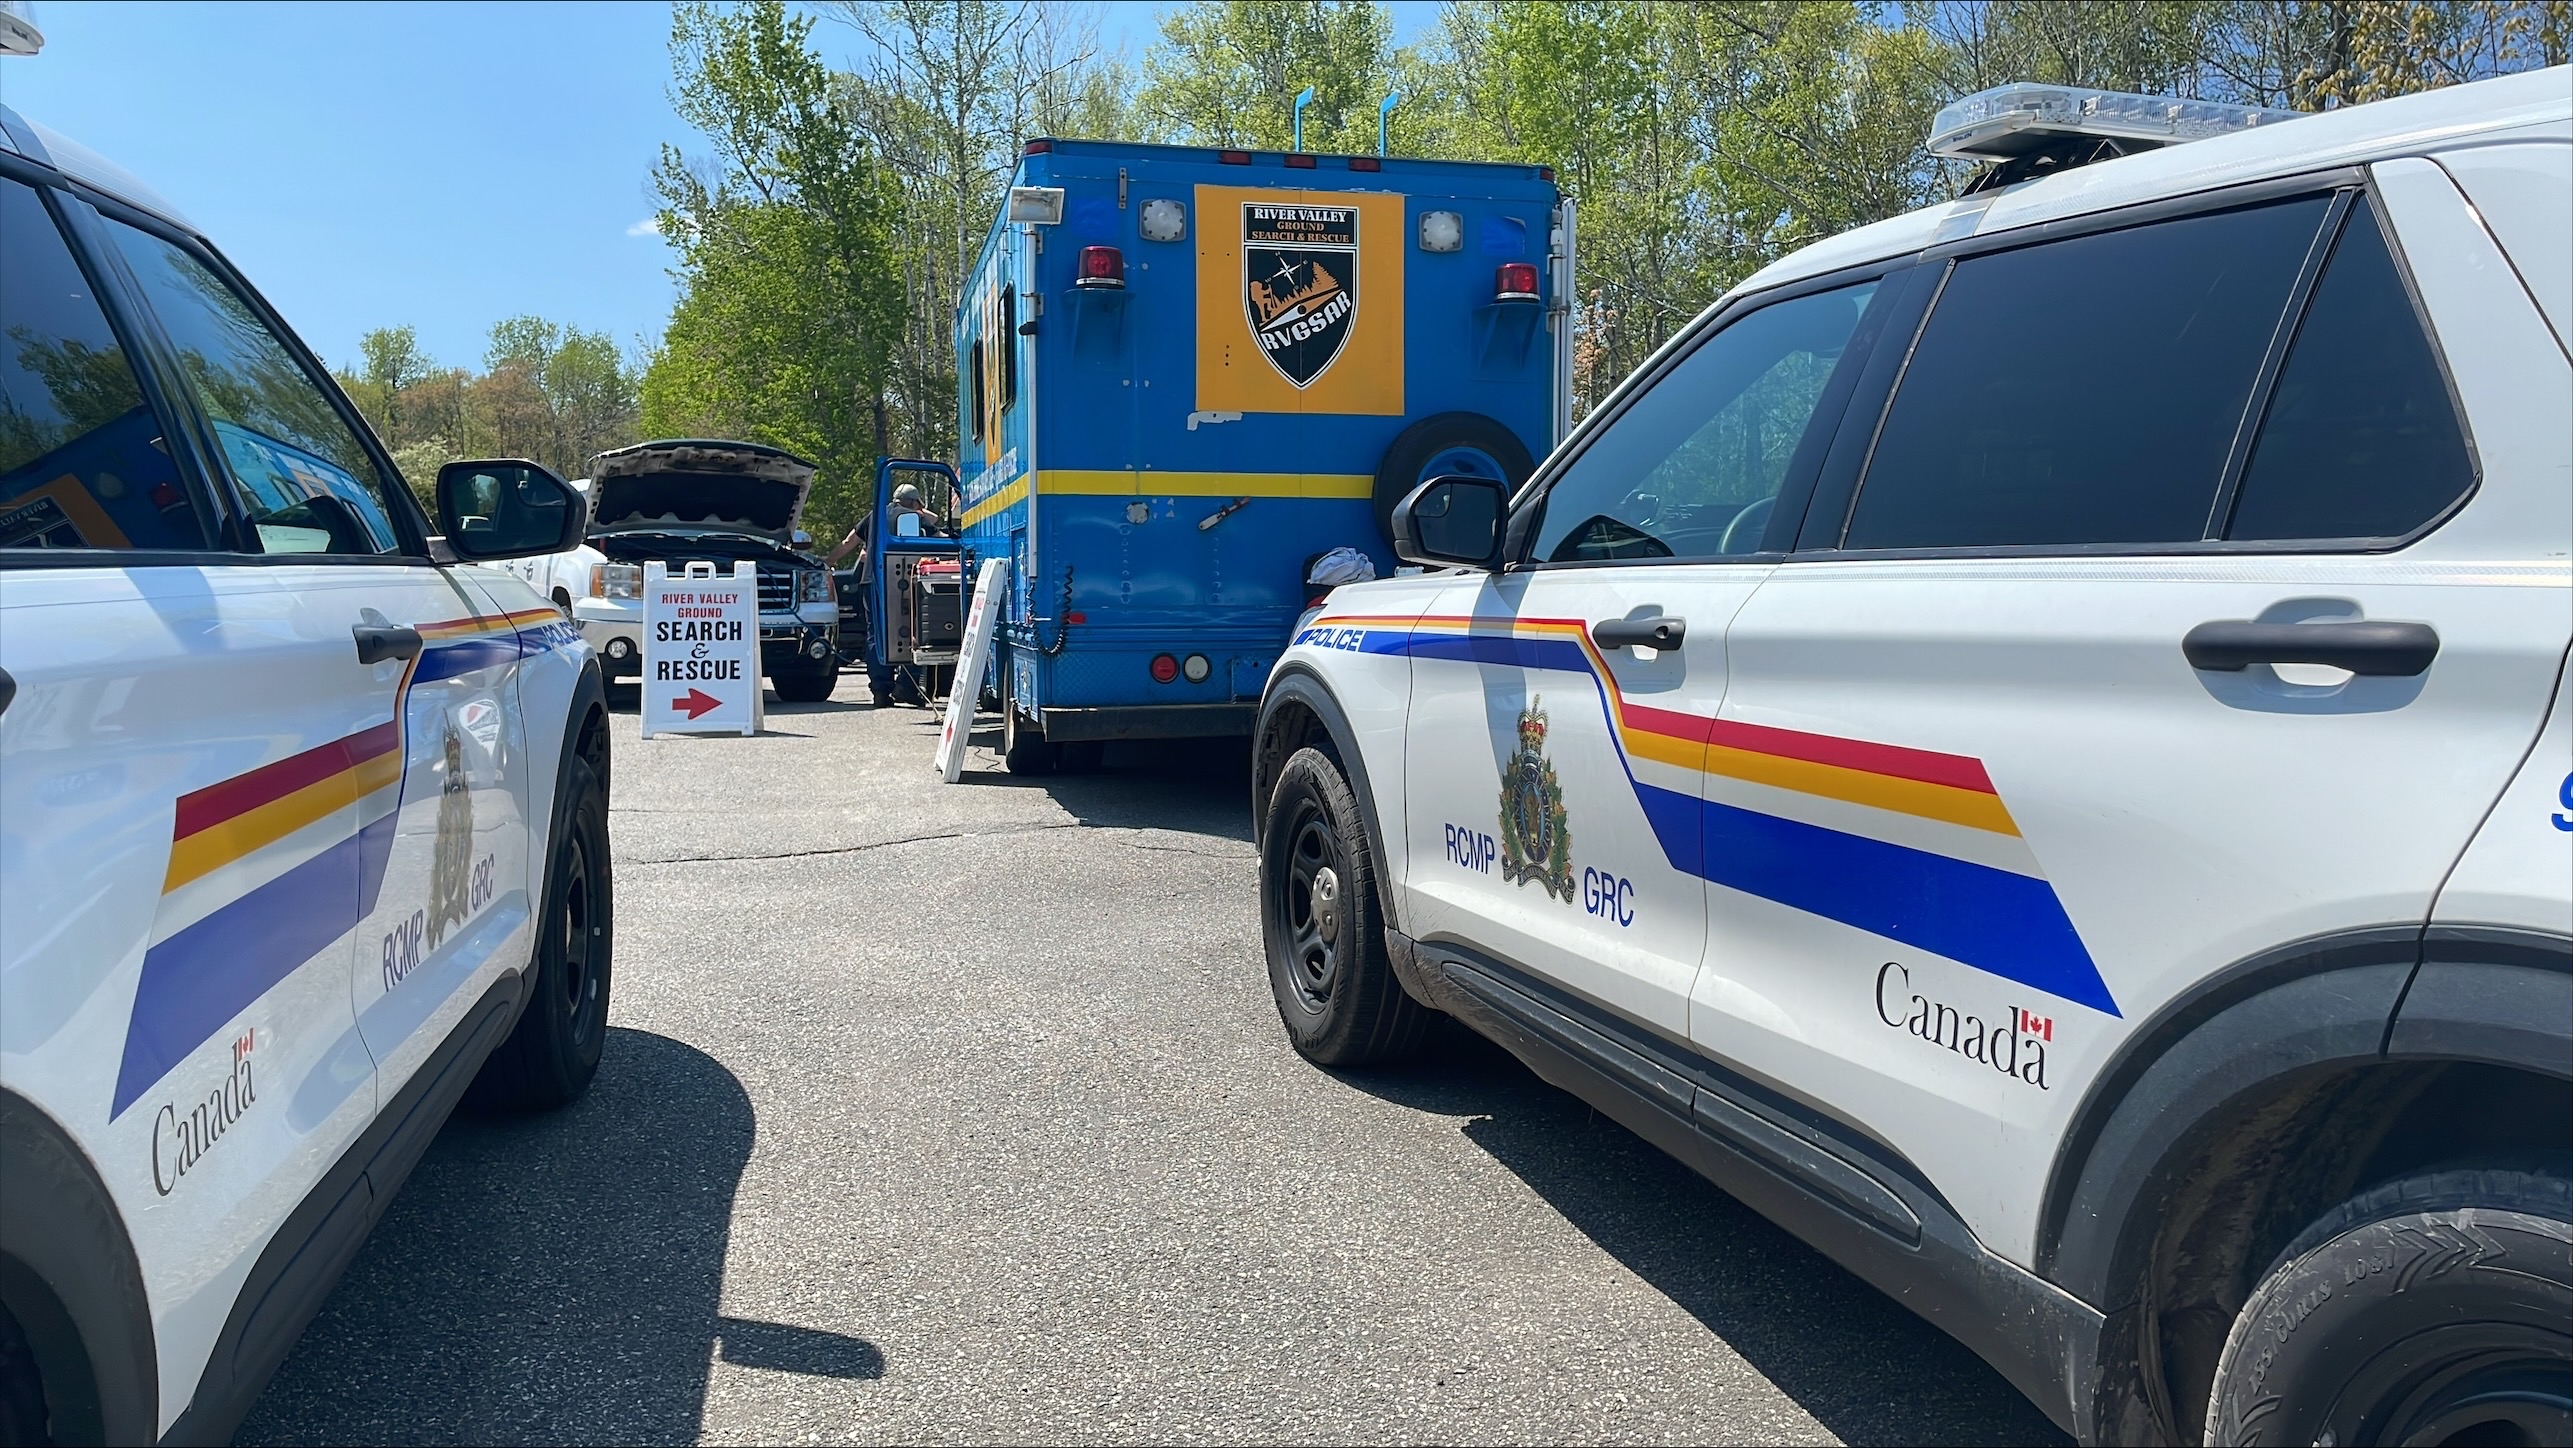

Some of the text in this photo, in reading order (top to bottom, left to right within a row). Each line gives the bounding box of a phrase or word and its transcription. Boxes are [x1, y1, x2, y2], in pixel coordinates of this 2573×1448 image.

[1254, 208, 1346, 222] RIVER VALLEY
[1277, 221, 1324, 231] GROUND
[1251, 231, 1349, 243] SEARCH & RESCUE
[1260, 290, 1352, 350] RVGSAR
[662, 593, 738, 604] RIVER VALLEY
[678, 607, 722, 618] GROUND
[542, 621, 581, 649] POLICE
[656, 621, 742, 641] SEARCH
[1304, 628, 1364, 652] POLICE
[691, 642, 709, 659] &
[657, 660, 741, 680] RESCUE
[1444, 822, 1496, 875] RCMP
[471, 853, 495, 912] GRC
[1583, 866, 1635, 928] GRC
[382, 909, 424, 992] RCMP
[1875, 961, 2050, 1091] Canada
[152, 1041, 256, 1197] Canada
